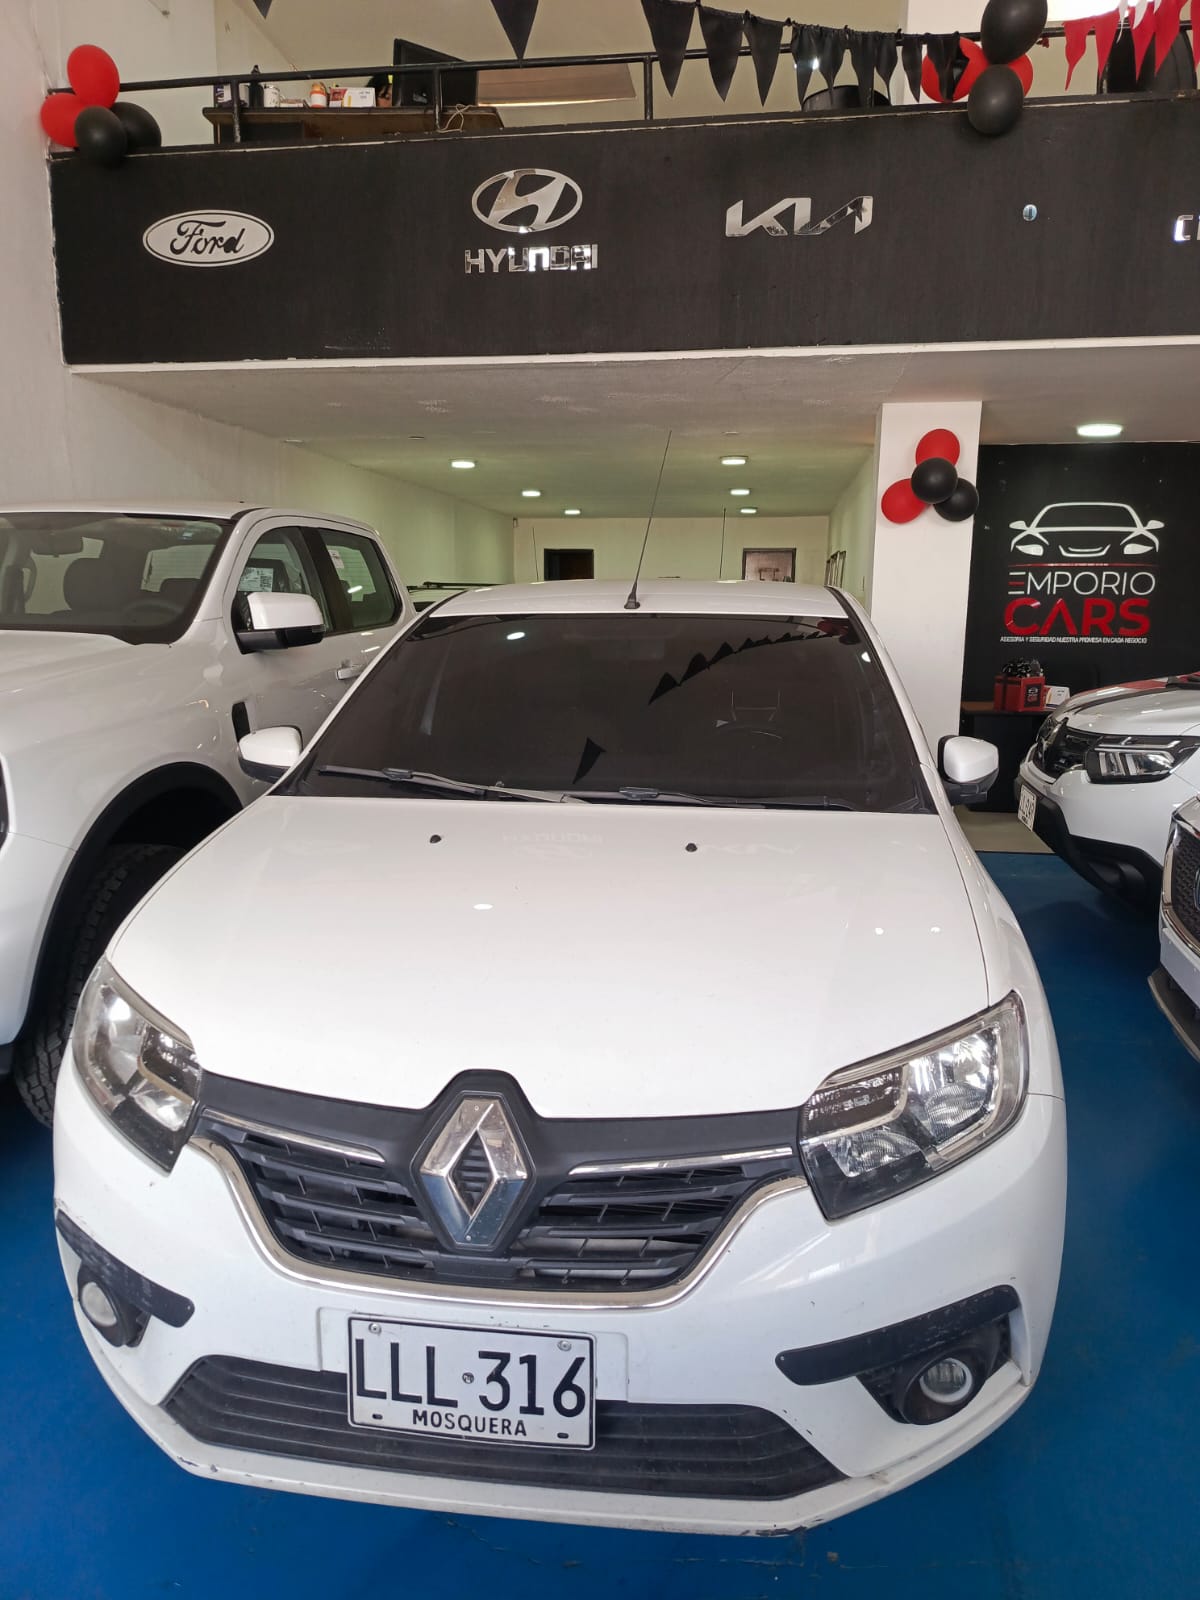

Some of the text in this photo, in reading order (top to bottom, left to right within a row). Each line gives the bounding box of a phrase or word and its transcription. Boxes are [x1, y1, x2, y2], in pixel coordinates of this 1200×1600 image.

[725, 196, 873, 237] KIA
[170, 220, 245, 255] Ford
[464, 244, 599, 273] HYUNDAI
[1008, 571, 1156, 595] EMPORIO
[1004, 597, 1151, 637] CARS
[355, 1338, 586, 1418] LLL 316
[412, 1409, 527, 1437] MOSQUERA
